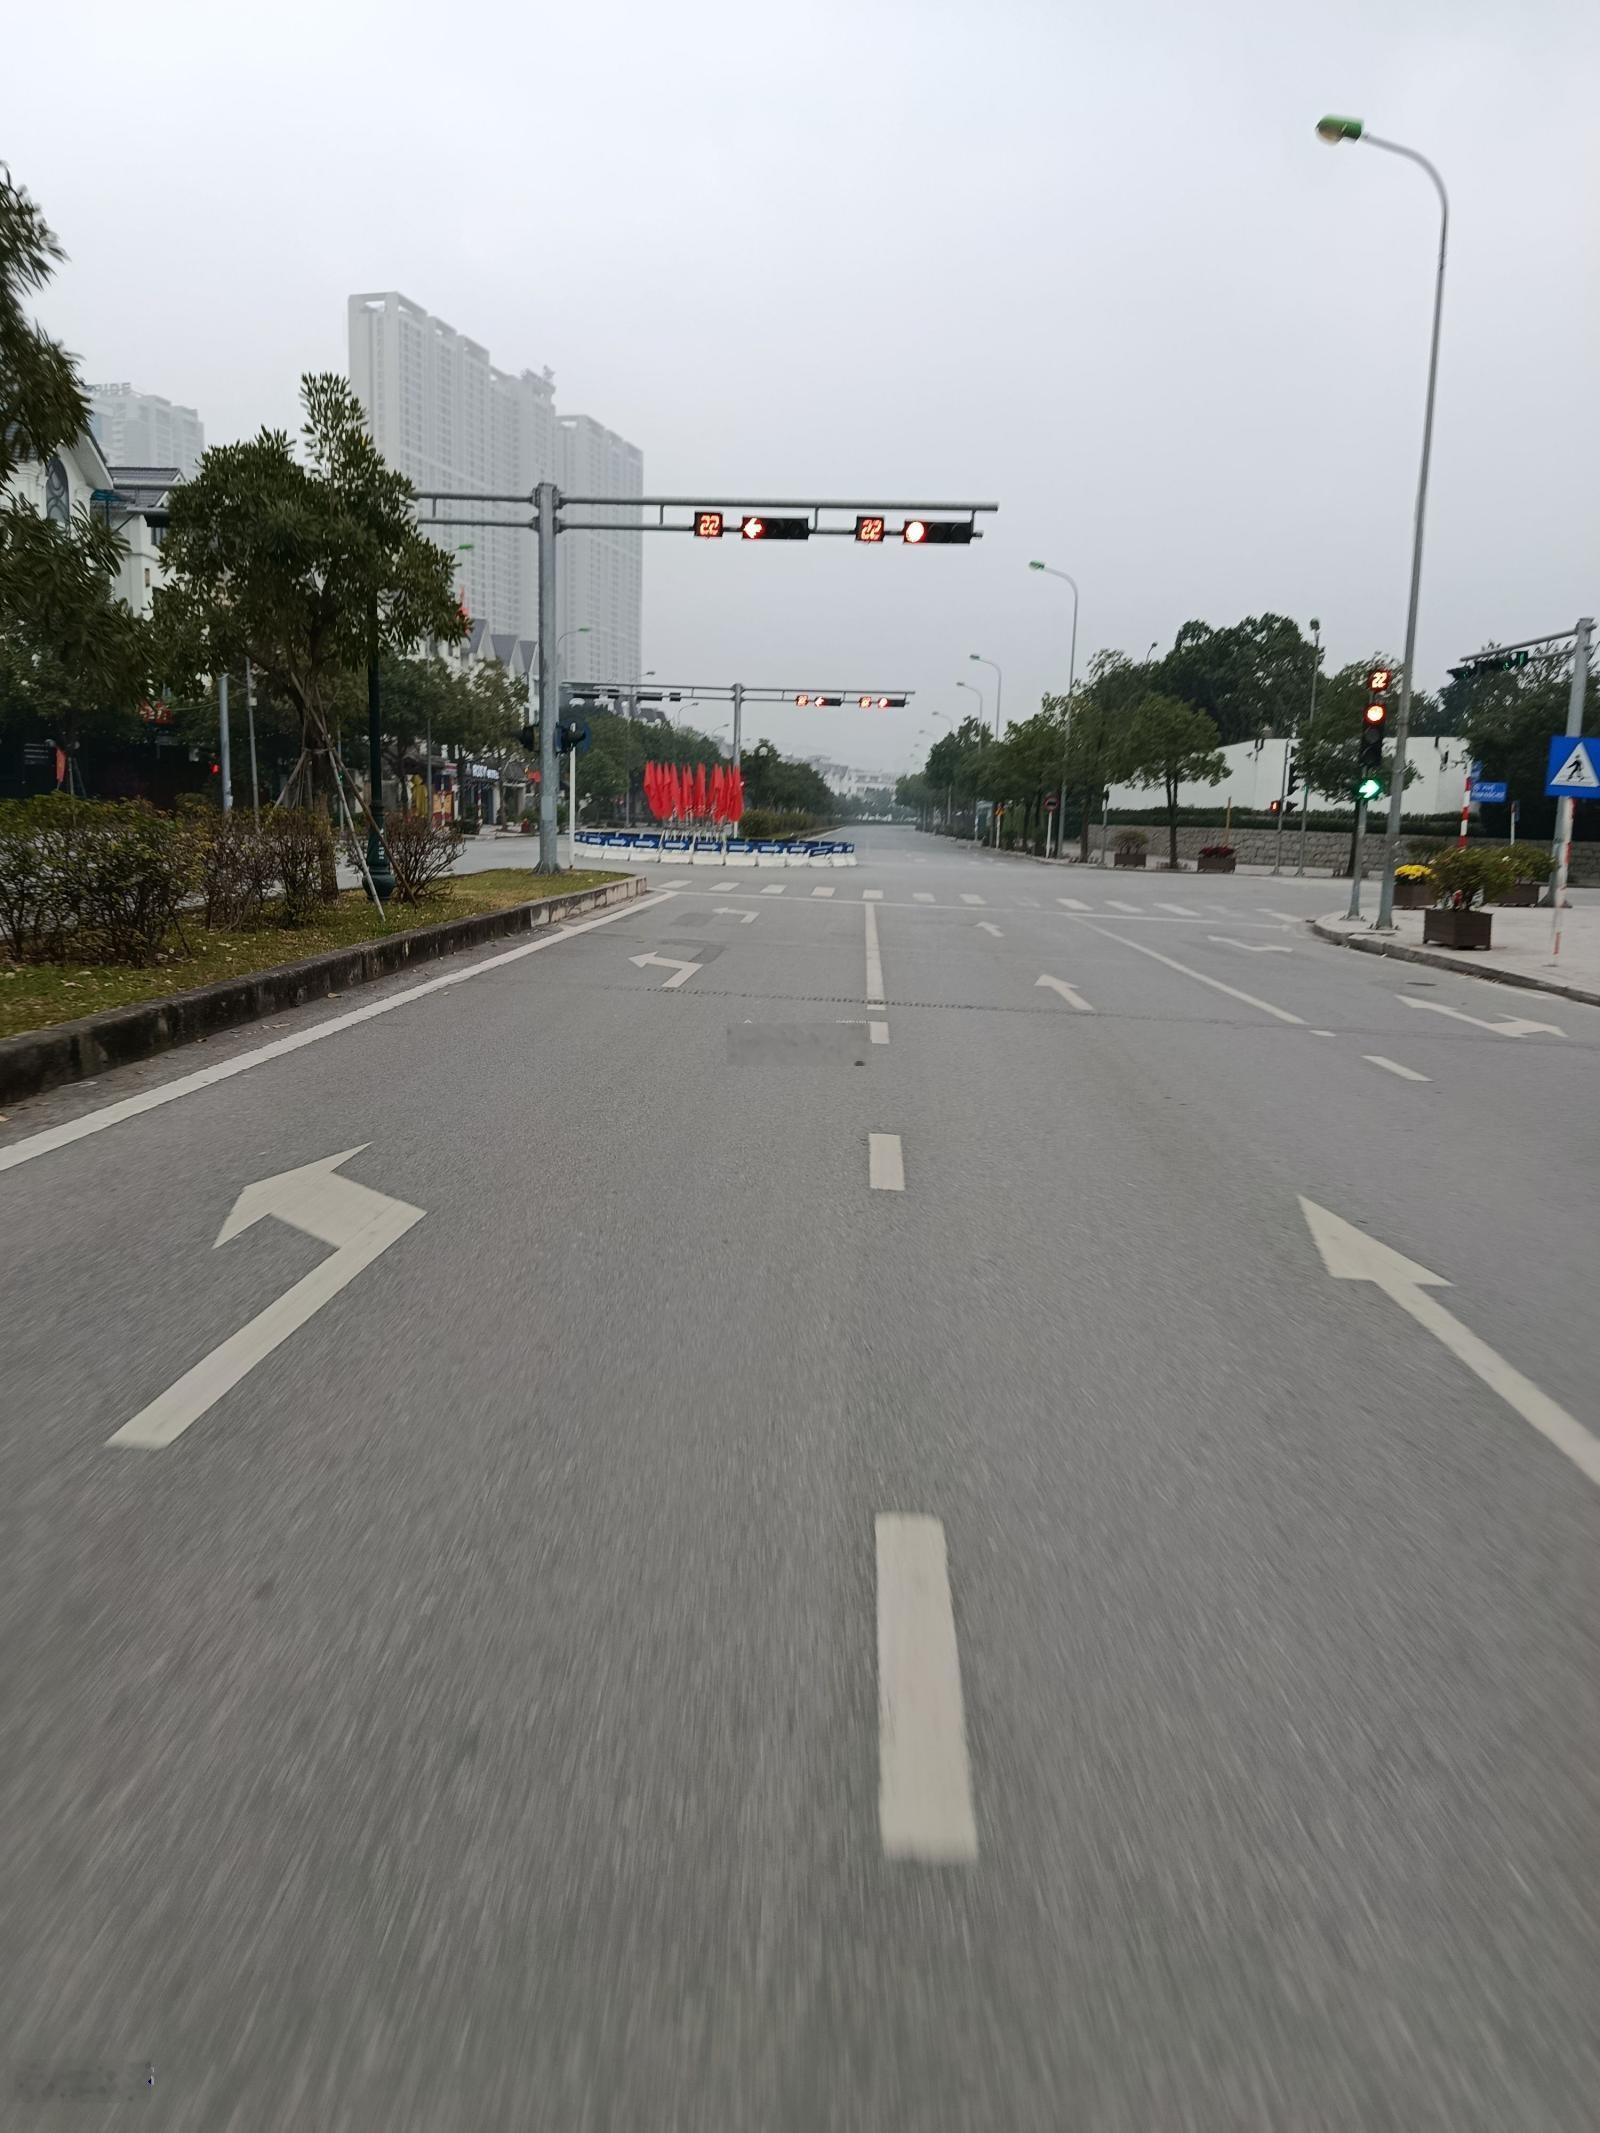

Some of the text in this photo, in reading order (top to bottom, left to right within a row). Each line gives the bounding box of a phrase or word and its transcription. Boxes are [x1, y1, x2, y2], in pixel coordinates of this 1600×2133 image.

[700, 515, 719, 536] 22
[861, 519, 882, 540] 22
[1372, 671, 1387, 688] 22
